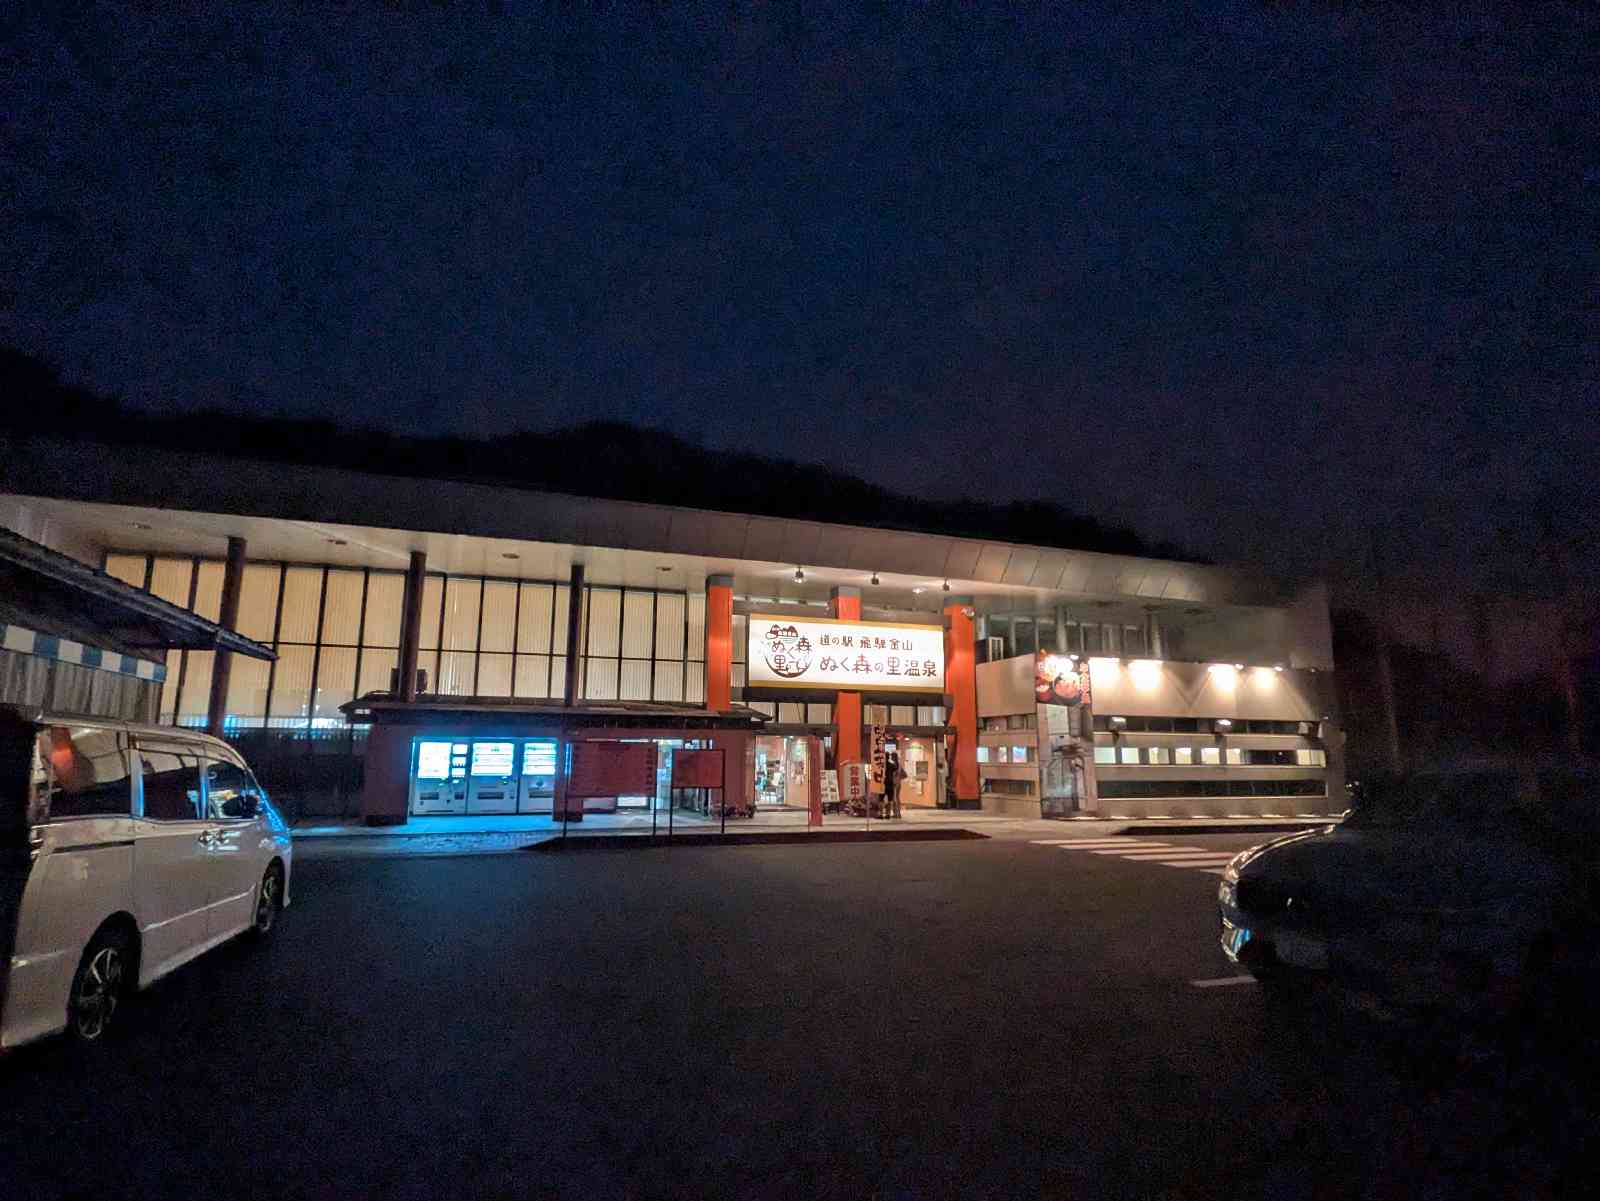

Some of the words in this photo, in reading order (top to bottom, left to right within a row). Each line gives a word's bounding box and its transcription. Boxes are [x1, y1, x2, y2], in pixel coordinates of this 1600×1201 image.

[820, 634, 853, 648] 道の駅
[820, 654, 937, 677] ぬく森の里温泉
